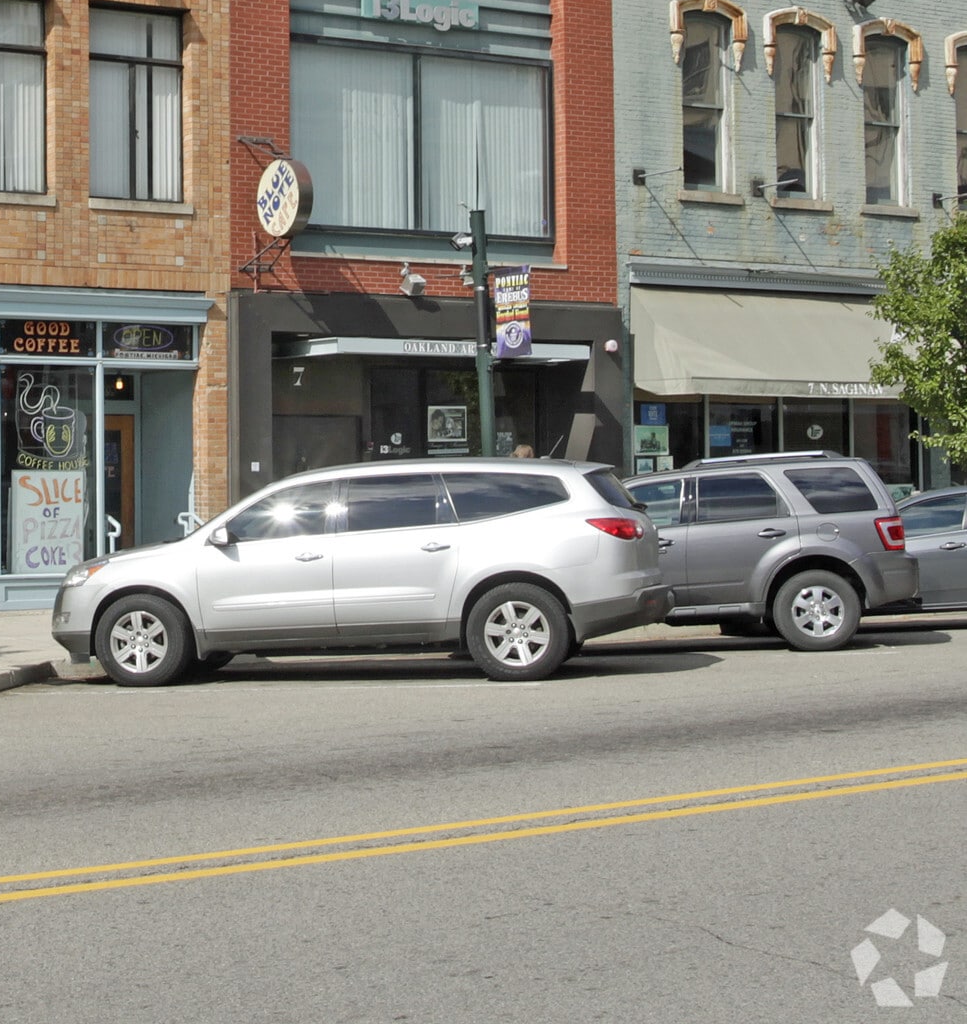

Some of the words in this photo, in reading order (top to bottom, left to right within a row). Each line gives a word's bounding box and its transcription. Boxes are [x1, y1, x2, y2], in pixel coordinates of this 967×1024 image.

[257, 160, 287, 211] BLUE
[263, 170, 294, 225] NOTE
[495, 273, 529, 288] PONTIAC
[496, 288, 529, 304] EREBUS
[24, 321, 70, 336] GOOD
[121, 327, 162, 347] OPEN
[13, 337, 80, 353] COFFEE
[404, 342, 455, 353] OAKLAND
[460, 344, 477, 354] AR
[293, 367, 305, 386] 7
[807, 383, 814, 394] 7
[819, 383, 830, 394] N.
[18, 453, 54, 470] COFFEE
[18, 475, 82, 506] SLICE
[43, 507, 60, 518] OF
[22, 517, 81, 544] PIZZA
[25, 545, 67, 569] COKE
